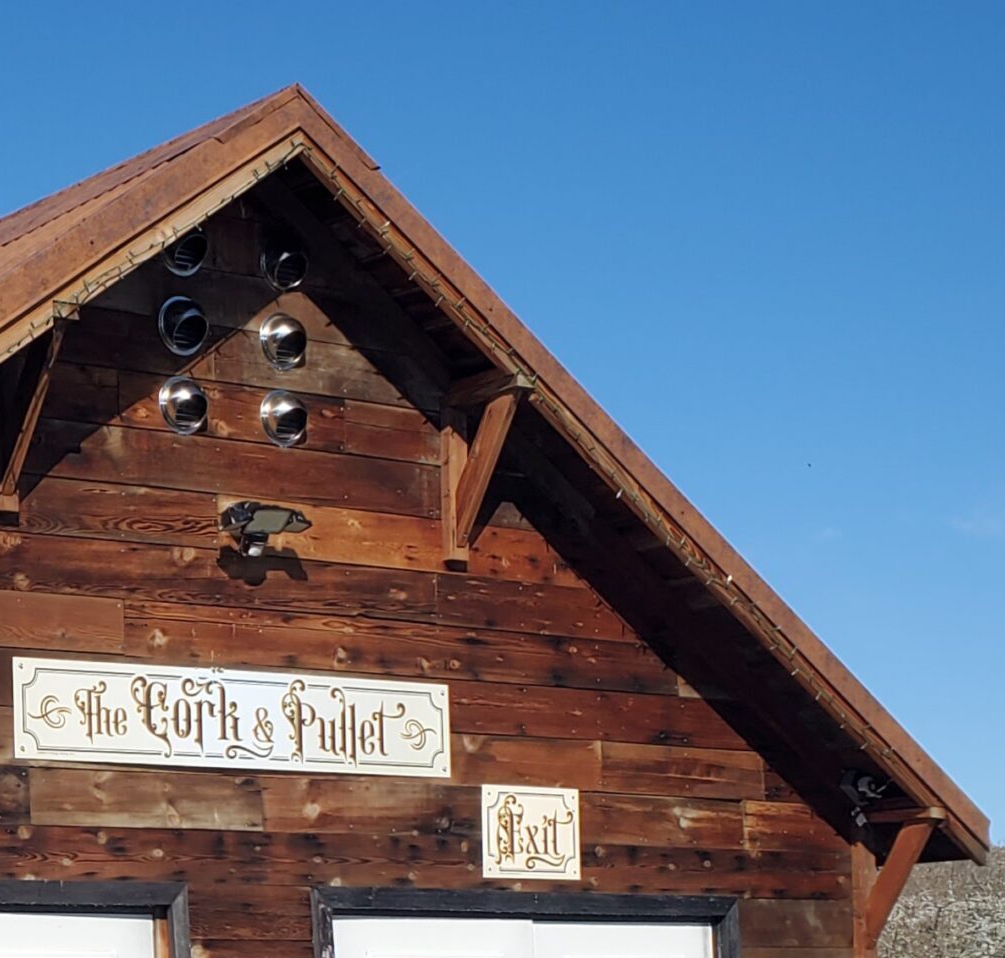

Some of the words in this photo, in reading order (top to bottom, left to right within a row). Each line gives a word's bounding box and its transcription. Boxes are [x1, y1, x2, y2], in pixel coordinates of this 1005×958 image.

[74, 681, 128, 745] The
[131, 675, 243, 758] Cork
[252, 707, 275, 744] &
[281, 679, 406, 767] Pullet
[495, 795, 573, 869] Exit
